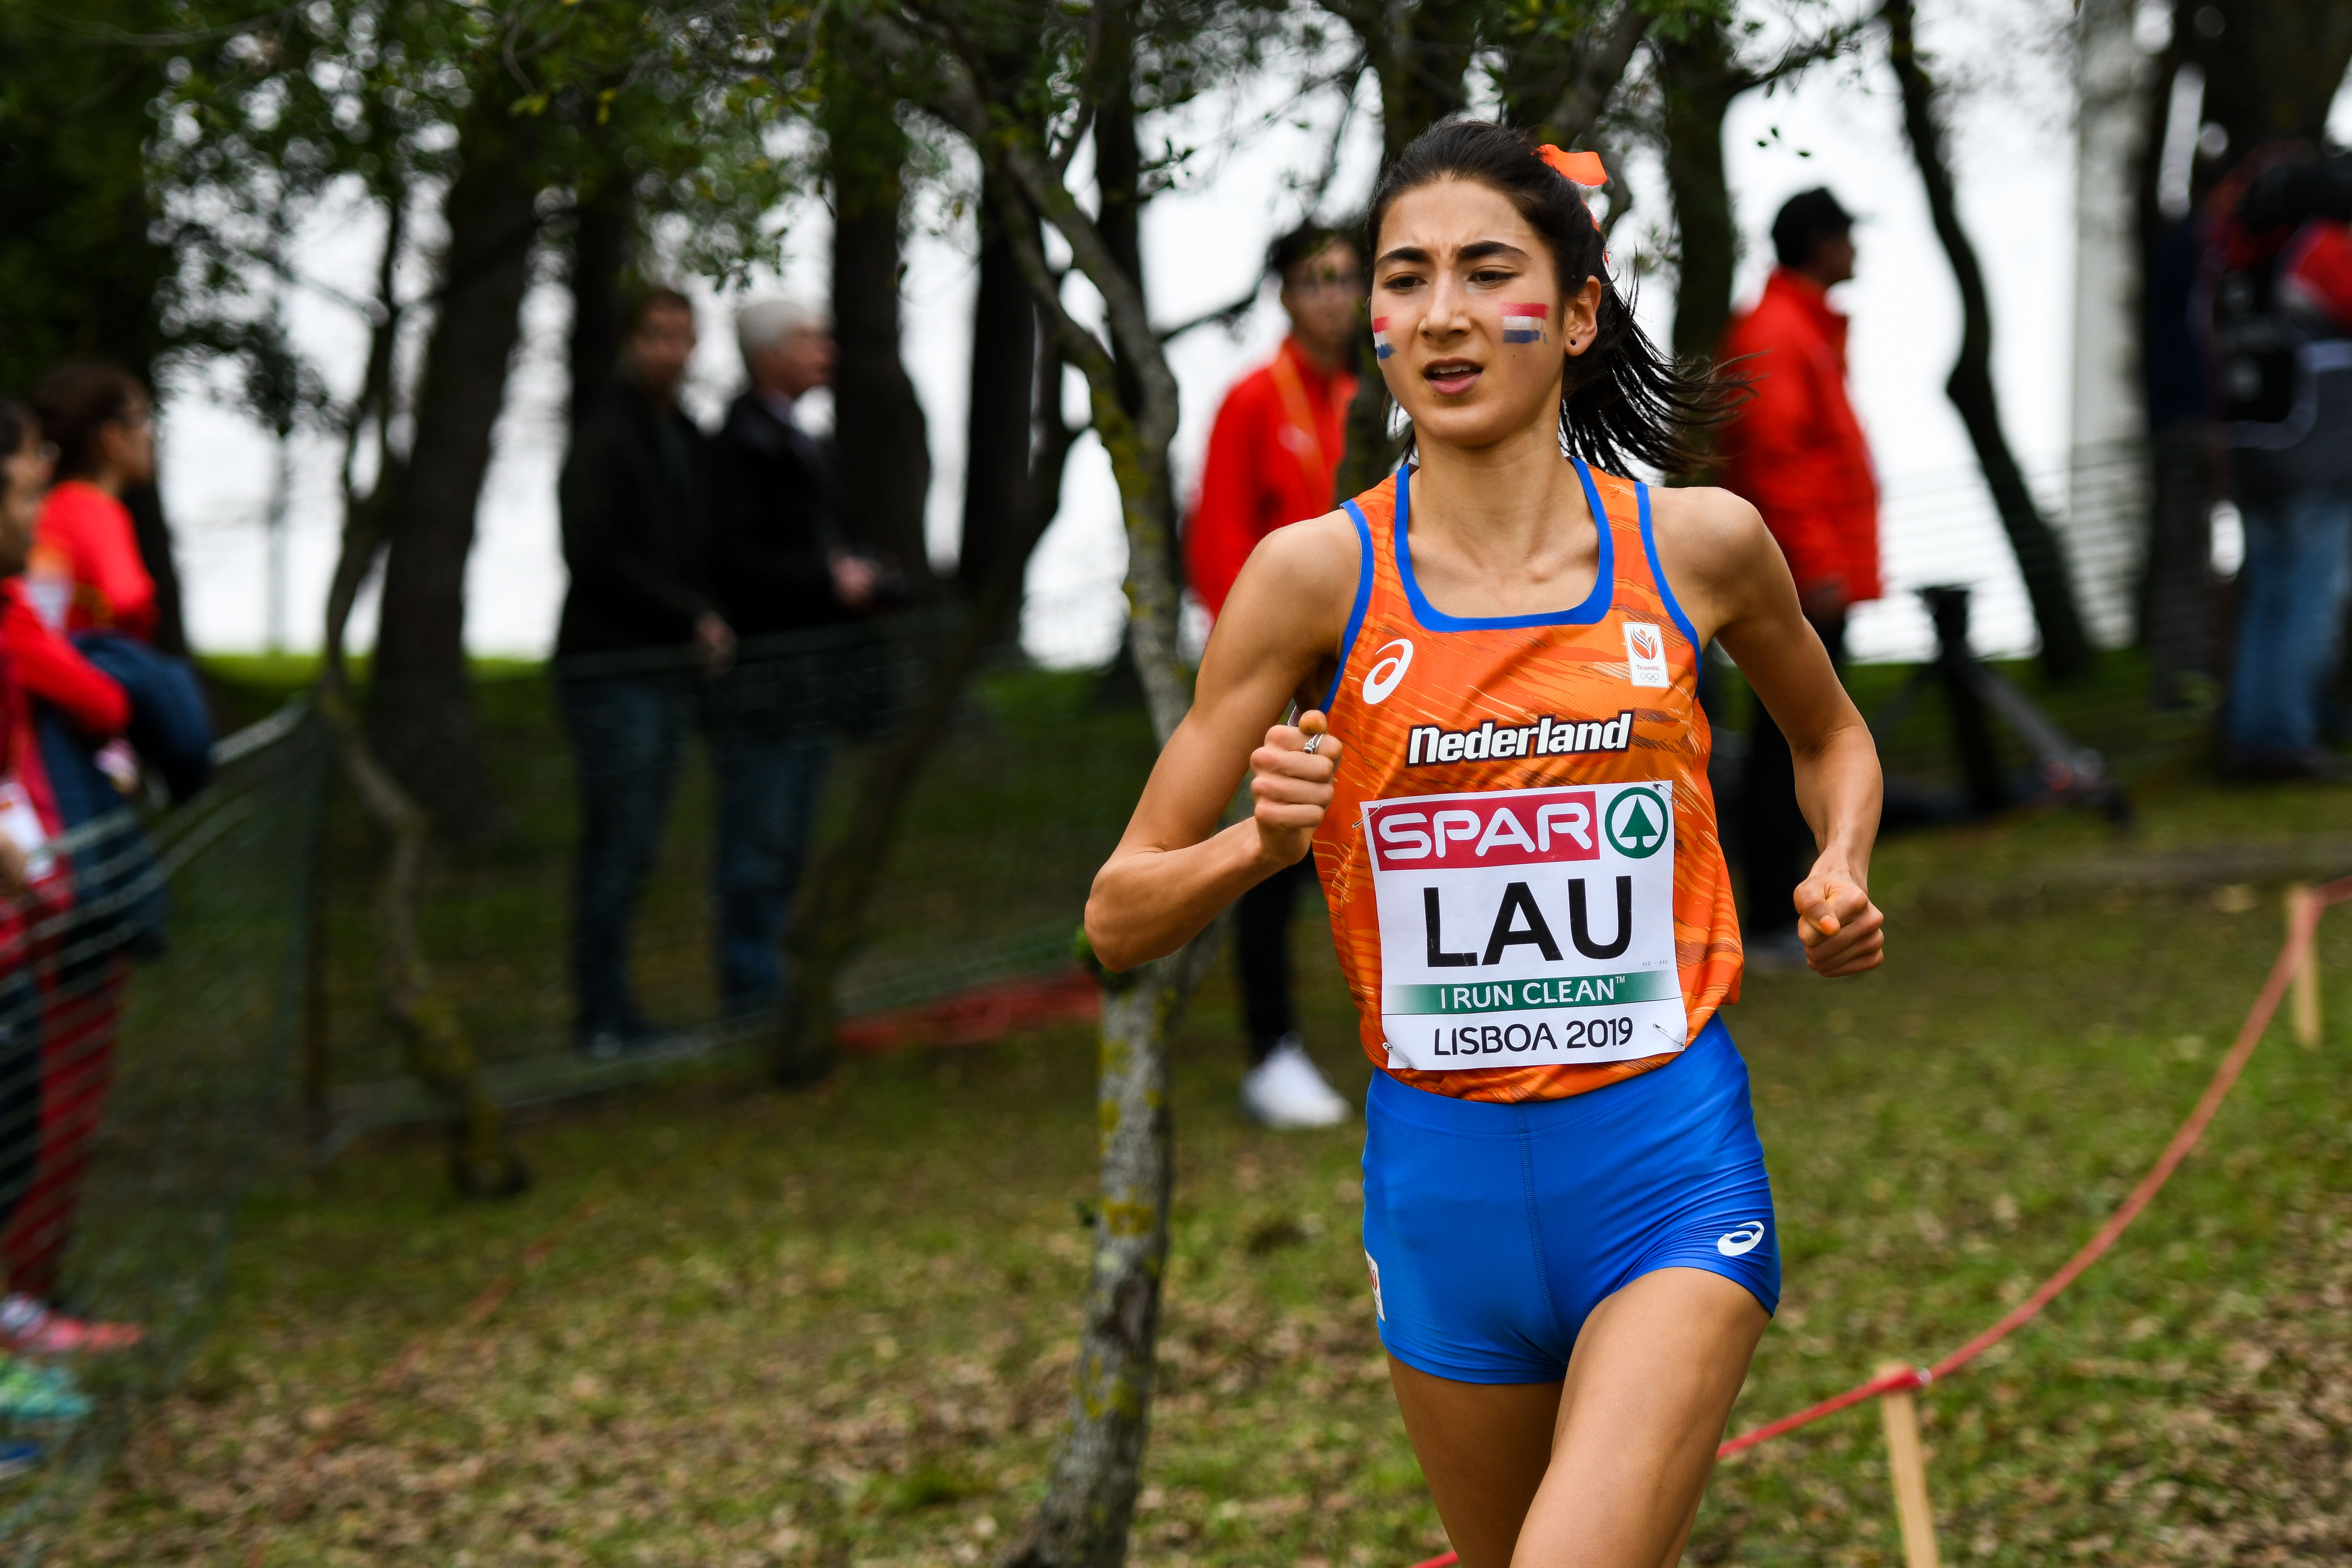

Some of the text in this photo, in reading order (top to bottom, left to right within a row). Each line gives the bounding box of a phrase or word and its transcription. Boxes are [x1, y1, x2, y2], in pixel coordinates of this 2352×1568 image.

[1378, 802, 1592, 860] SPAR
[1423, 875, 1632, 968] LAU
[1441, 988, 1446, 1009] I
[1454, 984, 1513, 1009] RUN
[1434, 1017, 1633, 1055] LISBOA 2019
